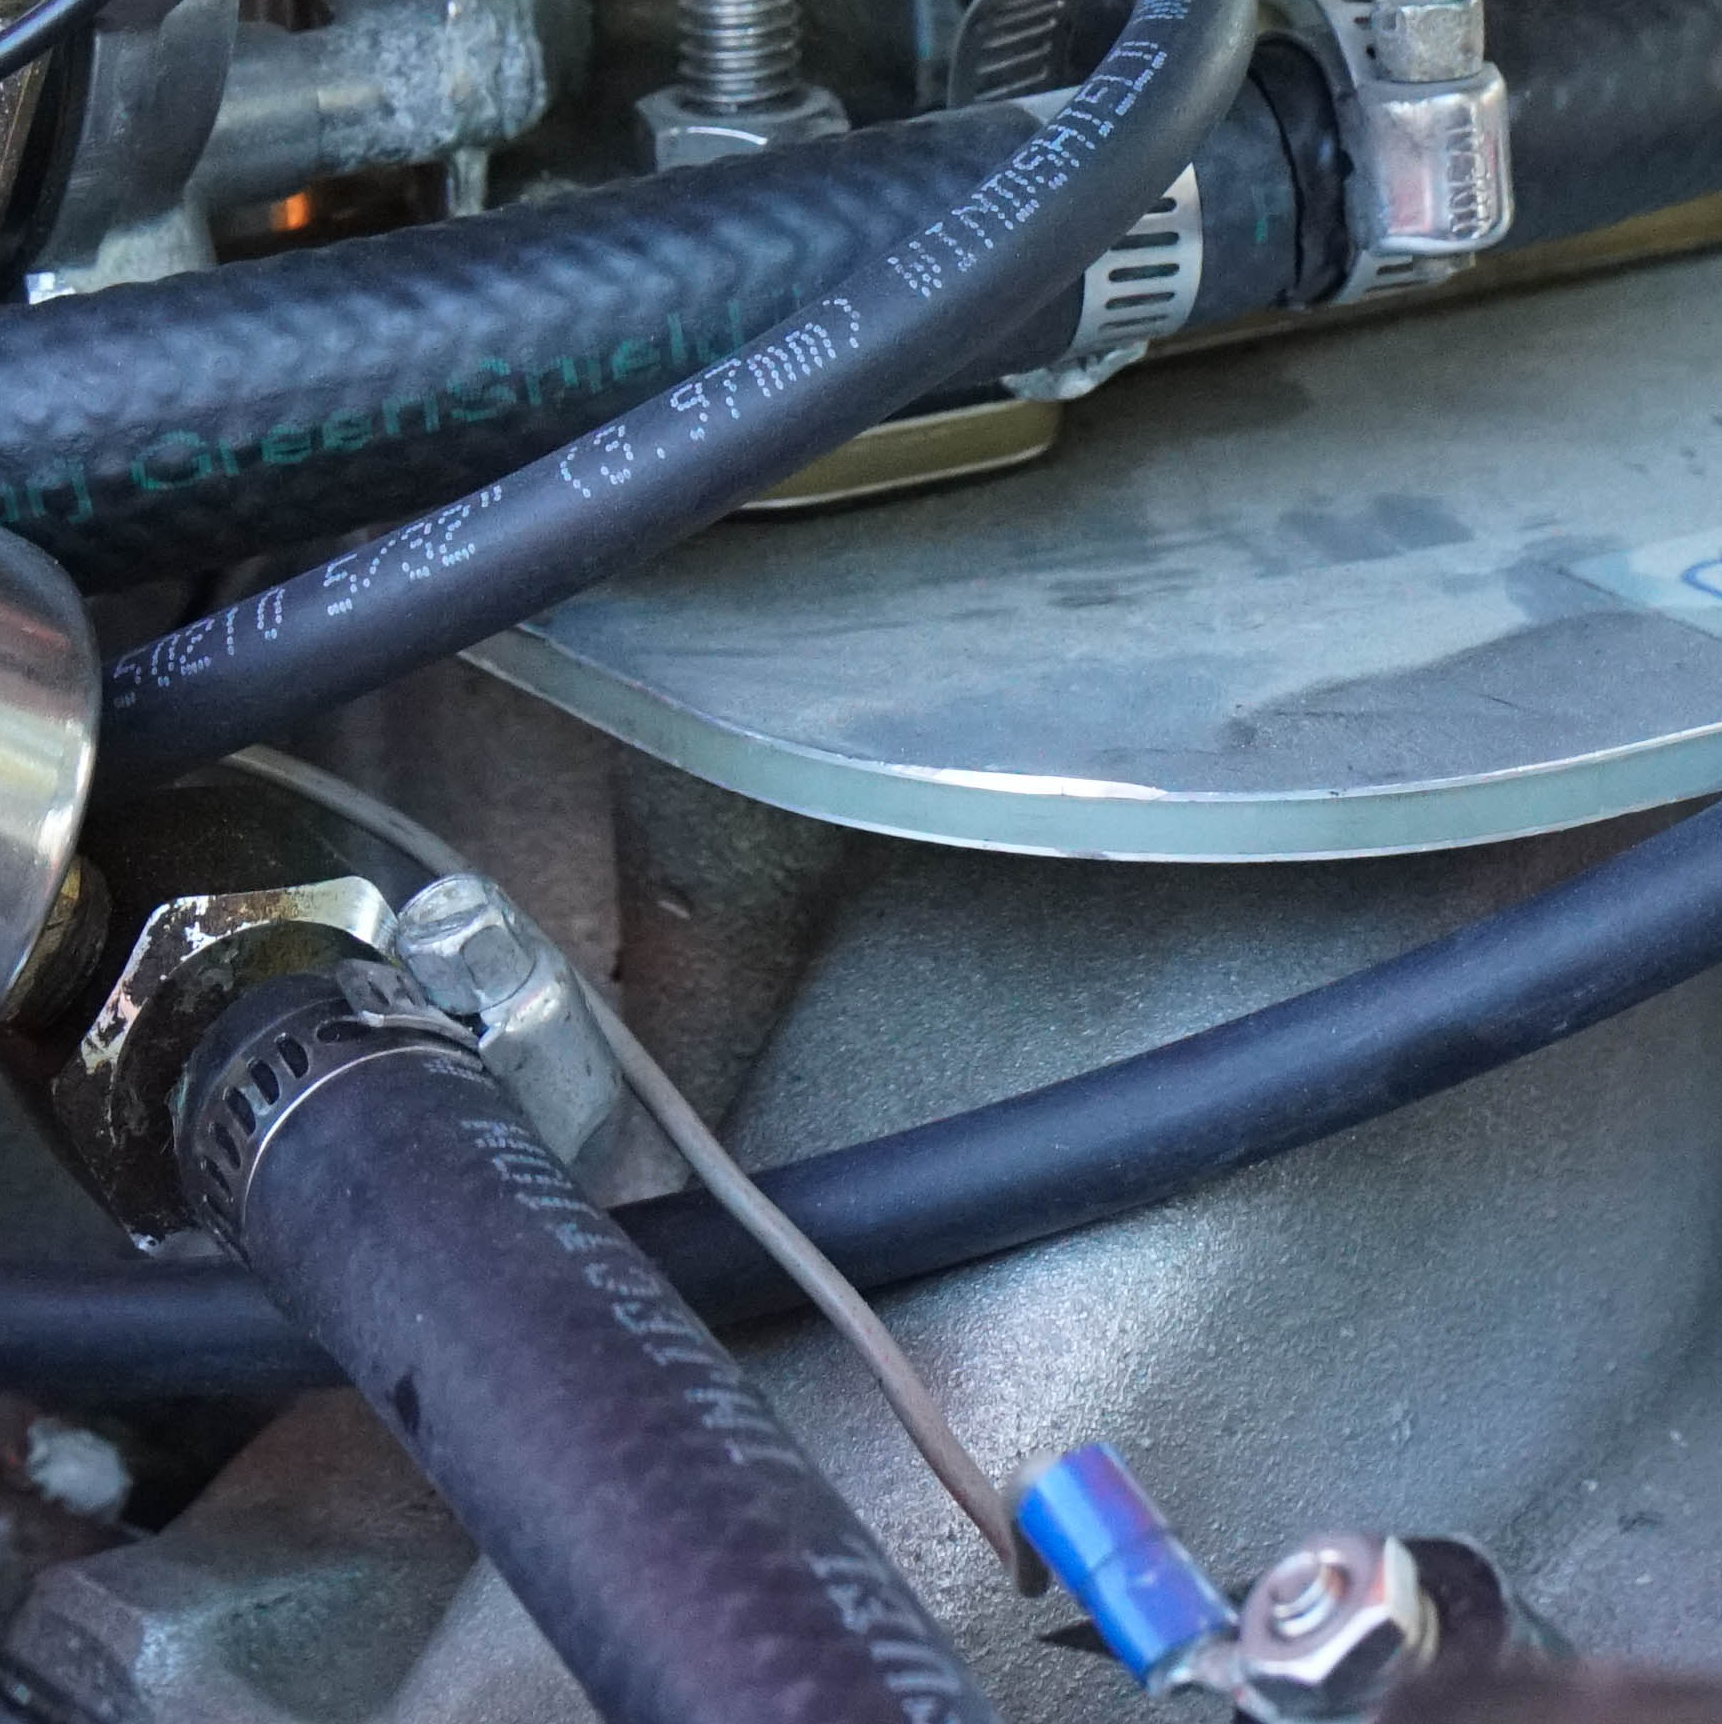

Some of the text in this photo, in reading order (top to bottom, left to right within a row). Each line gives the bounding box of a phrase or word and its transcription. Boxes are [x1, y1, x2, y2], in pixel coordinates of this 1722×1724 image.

[324, 485, 503, 617] 5/32"
[560, 296, 861, 499] (3.97mm)
[887, 40, 1167, 297] WINDSHIELD
